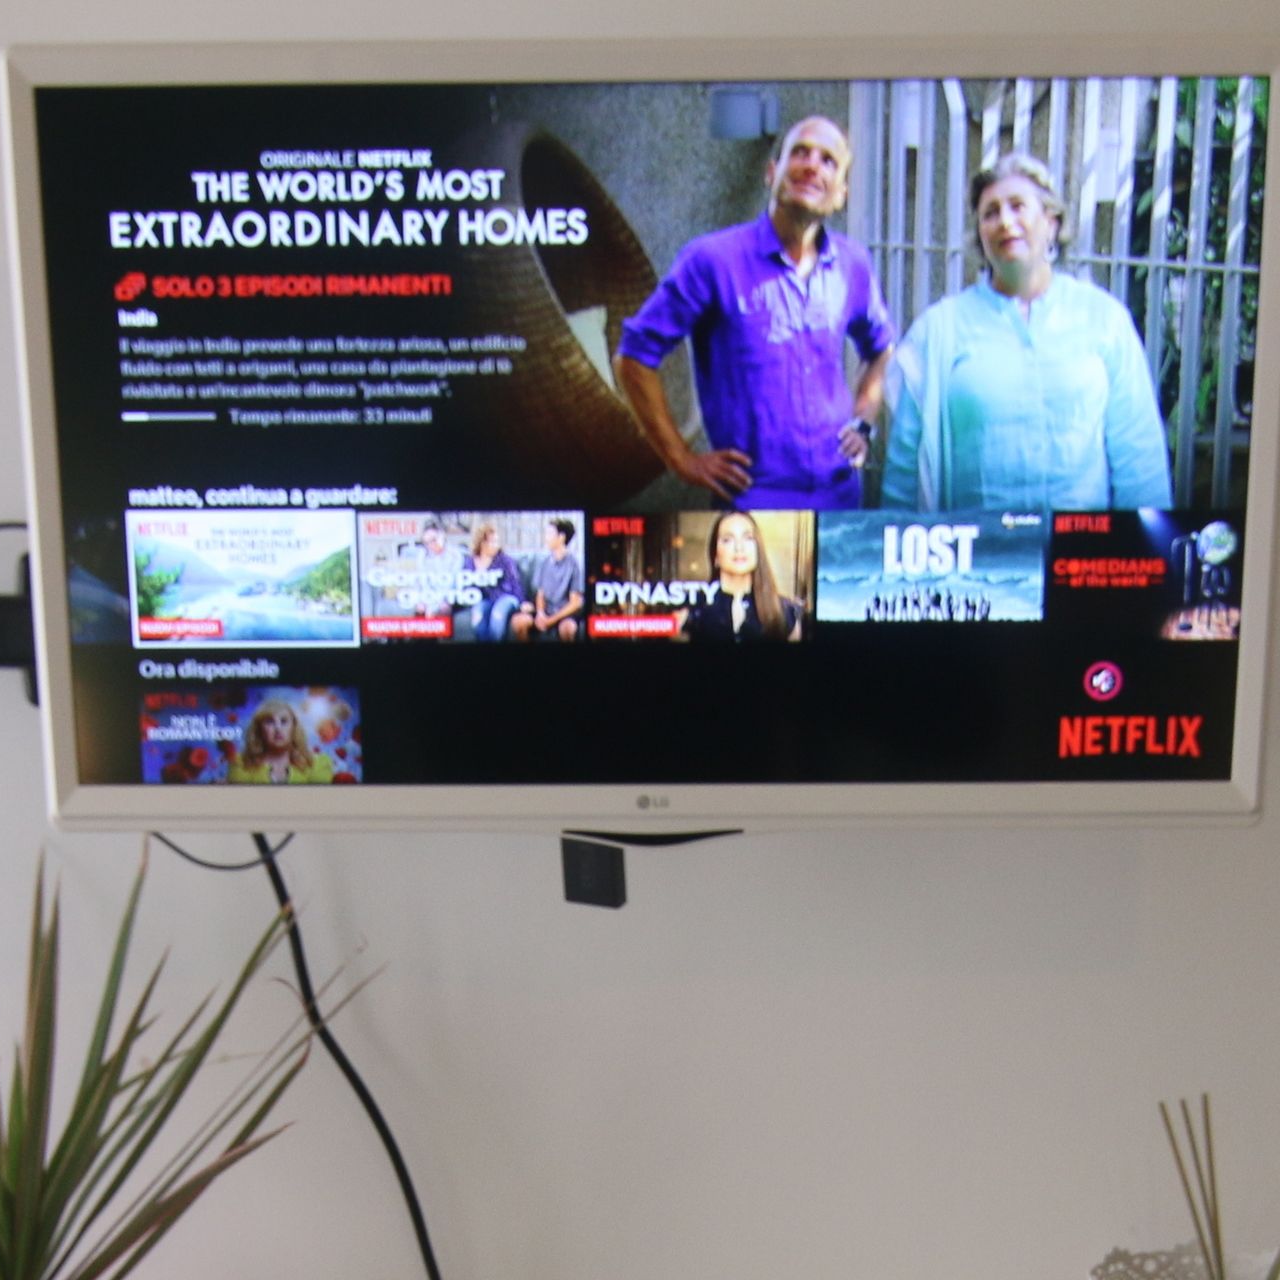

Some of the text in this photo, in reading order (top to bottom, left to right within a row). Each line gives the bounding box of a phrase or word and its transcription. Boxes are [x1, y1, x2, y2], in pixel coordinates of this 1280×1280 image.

[260, 150, 432, 168] ORIGINALE NETFLIX
[192, 170, 506, 202] THE WORLD'S MOST
[108, 208, 589, 248] EXTRAORDINARY HOMES
[152, 274, 451, 297] SOLO 3 EPISODI RIMANENTI
[118, 307, 157, 327] India
[229, 408, 282, 427] Tempo
[128, 484, 398, 509] matteo, continua a guardare:
[1054, 514, 1111, 533] NETFLIX
[882, 523, 980, 576] LOST
[1053, 558, 1167, 575] COMEDIANS
[456, 568, 503, 593] per
[595, 581, 720, 606] DYNASTY
[139, 658, 280, 682] Ora disponibile
[1058, 716, 1203, 759] NETFLIX
